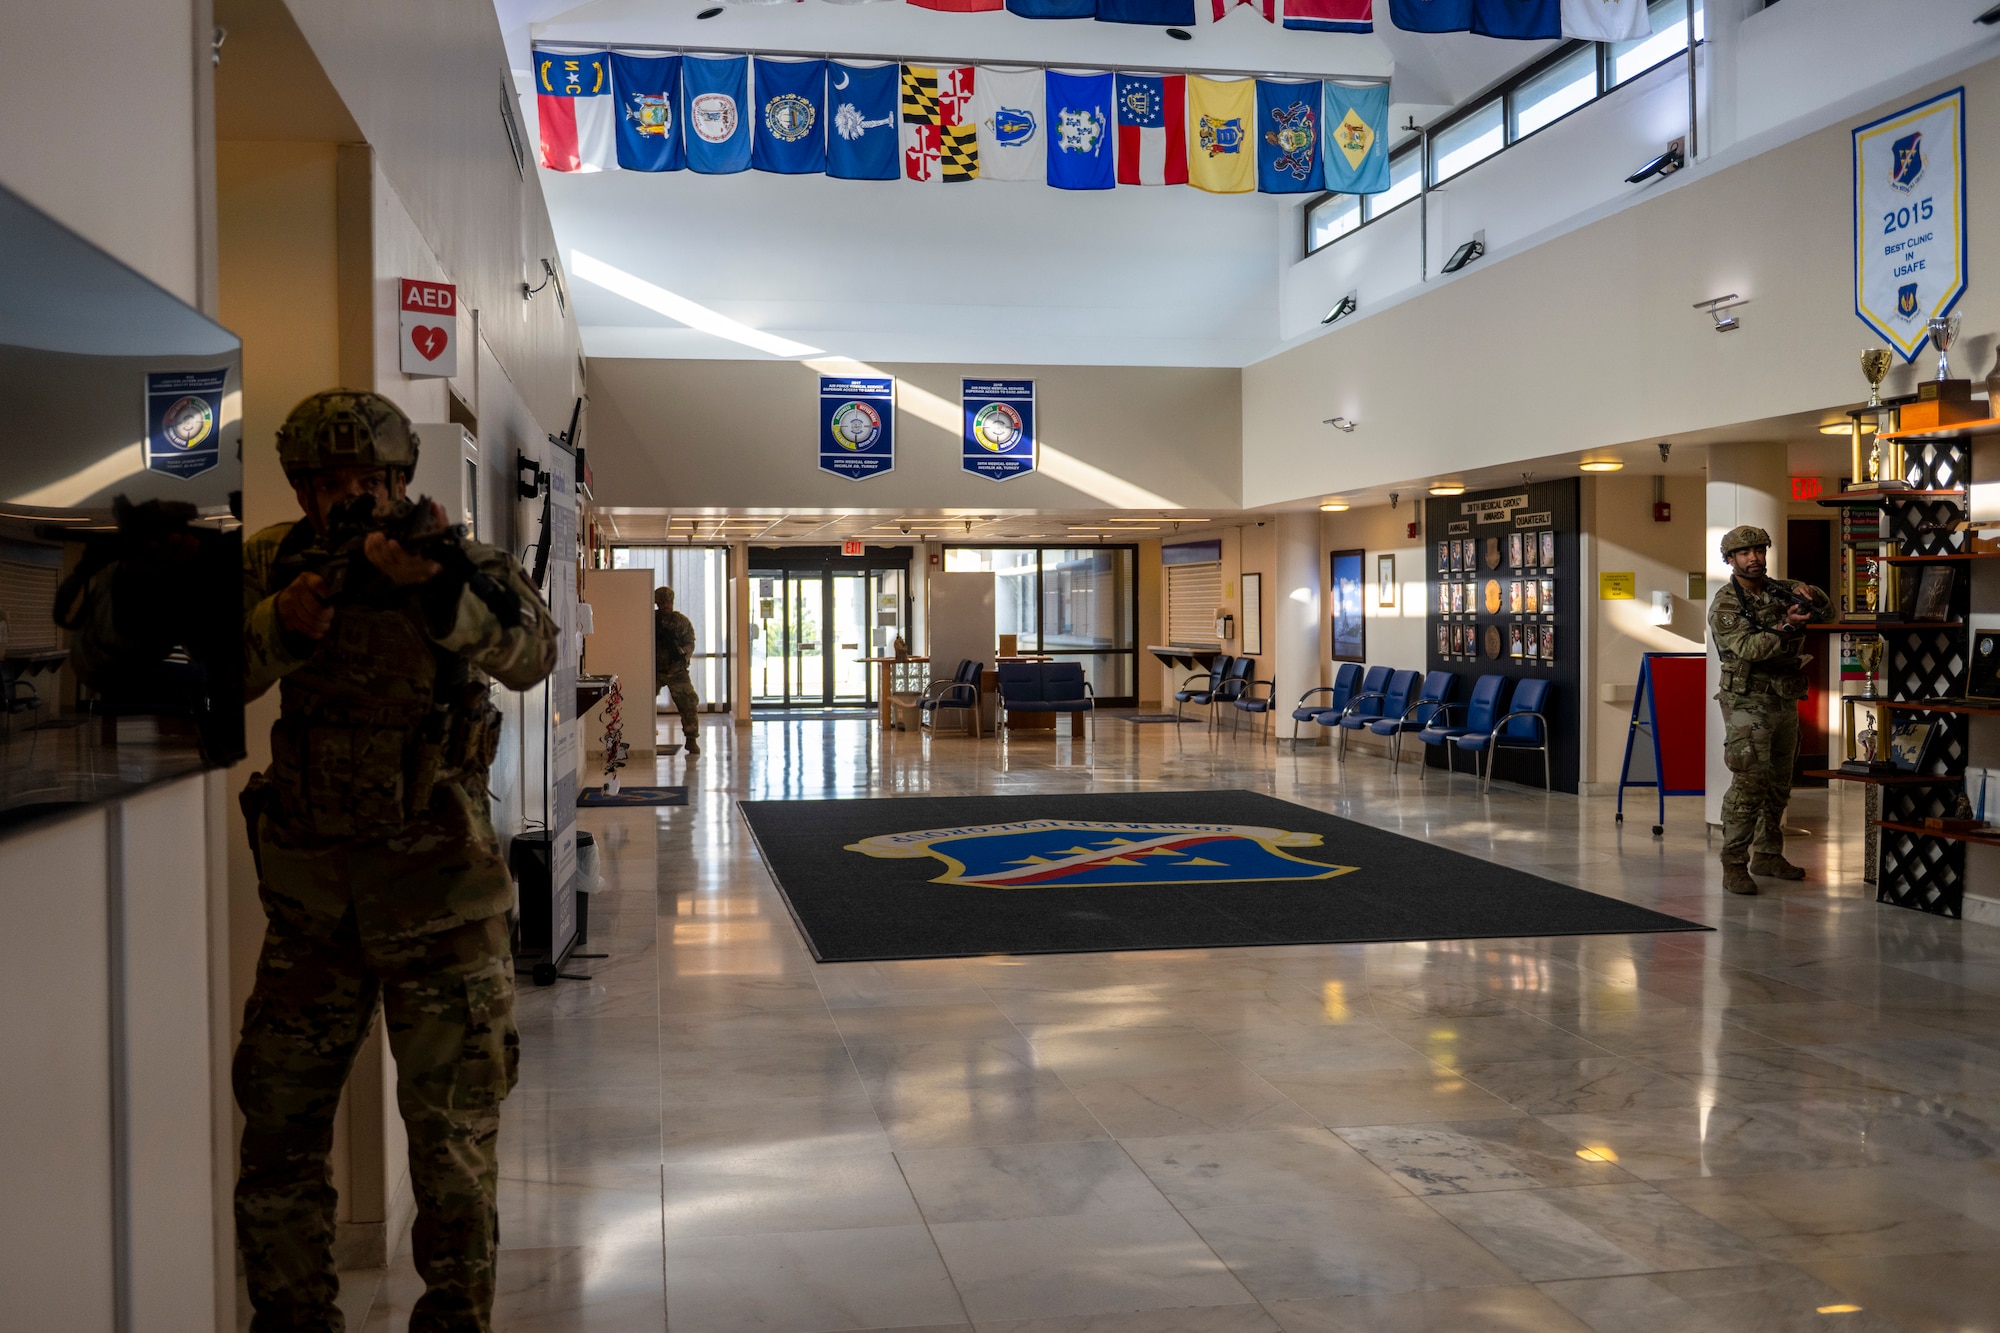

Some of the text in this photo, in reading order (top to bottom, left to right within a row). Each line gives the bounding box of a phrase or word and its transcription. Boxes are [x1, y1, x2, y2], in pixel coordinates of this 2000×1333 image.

[1883, 196, 1934, 235] 2015
[1905, 251, 1914, 262] IN
[1893, 259, 1926, 278] USAFE
[407, 286, 453, 309] AED
[1792, 478, 1818, 500] EXIT
[1480, 500, 1502, 511] MEDICAL
[1503, 497, 1522, 508] GROUP
[1483, 510, 1505, 521] AWARDS
[1516, 513, 1551, 526] QUARTERLY
[845, 541, 862, 554] EXIT
[991, 820, 1153, 831] MEDICAL
[888, 826, 988, 843] GROUP
